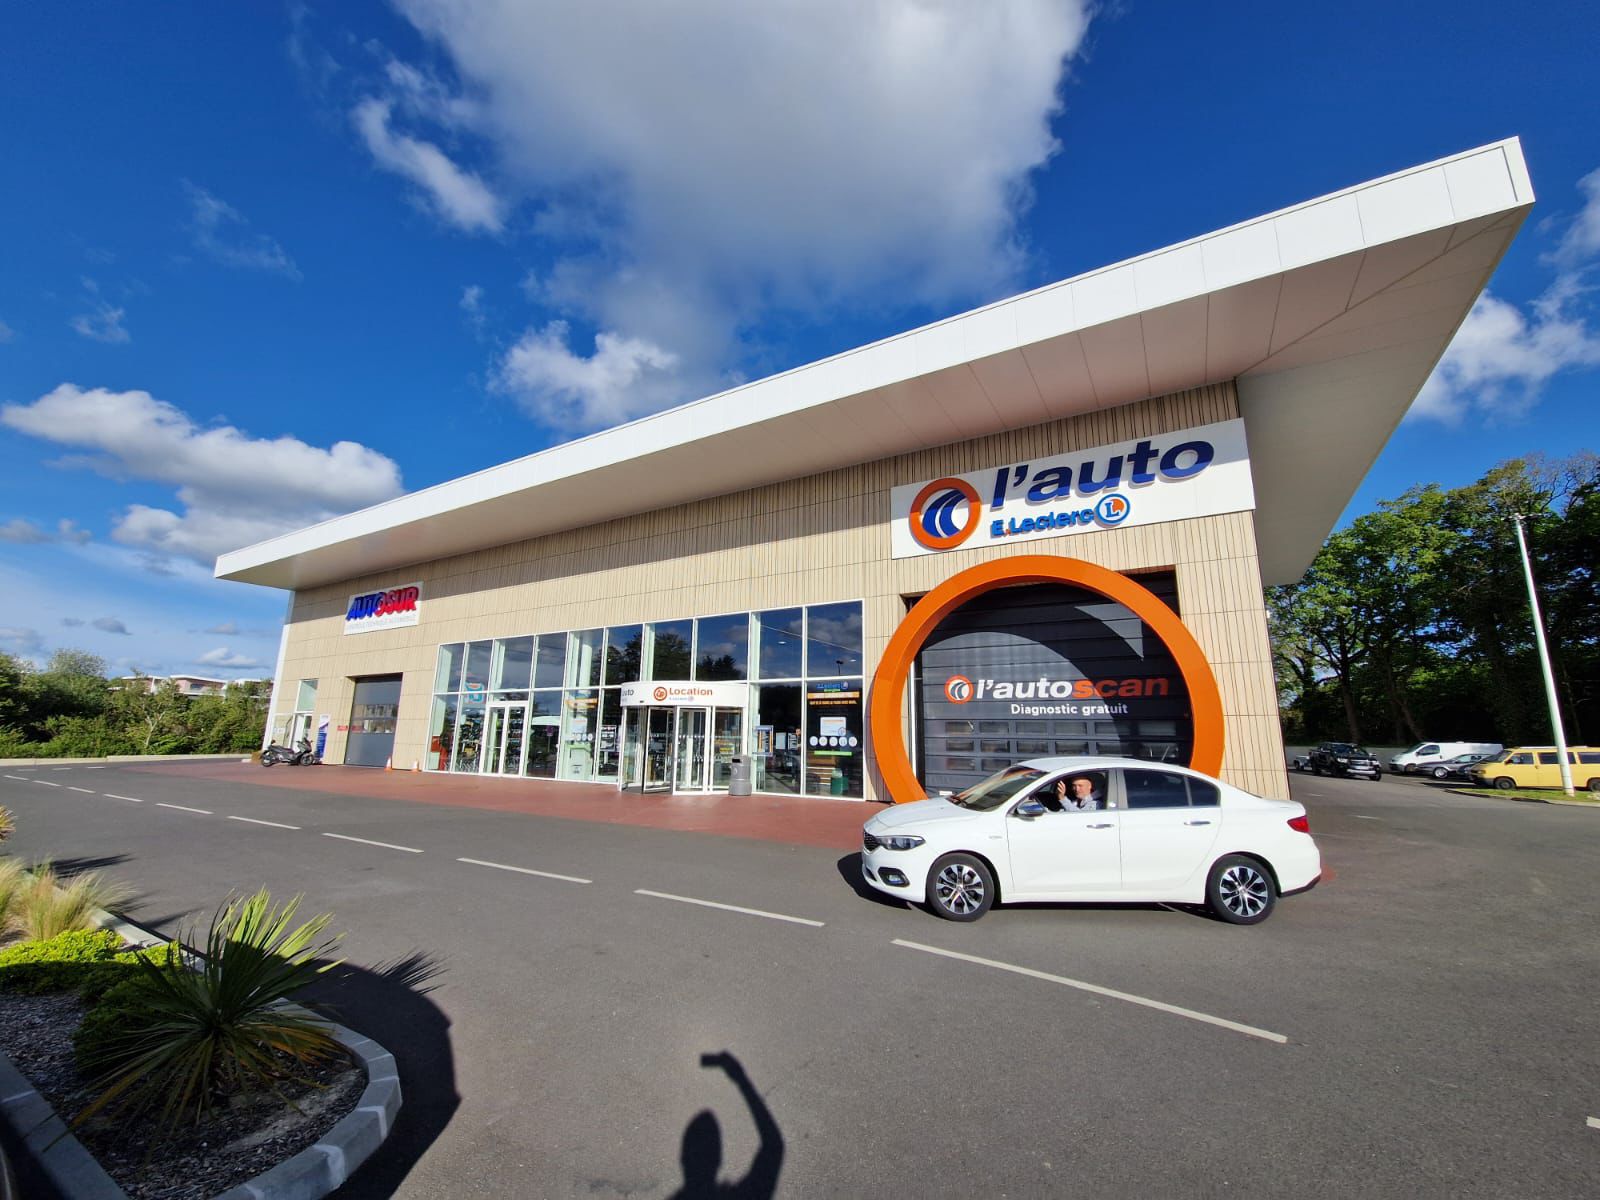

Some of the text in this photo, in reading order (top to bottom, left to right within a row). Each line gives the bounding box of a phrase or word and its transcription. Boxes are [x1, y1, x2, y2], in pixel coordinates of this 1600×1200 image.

[991, 440, 1214, 509] l'auto
[991, 508, 1095, 536] E.Leclerc
[345, 586, 420, 621] AUTOSUR
[669, 687, 713, 696] Location
[1010, 703, 1129, 716] Diagnostic gratuit
